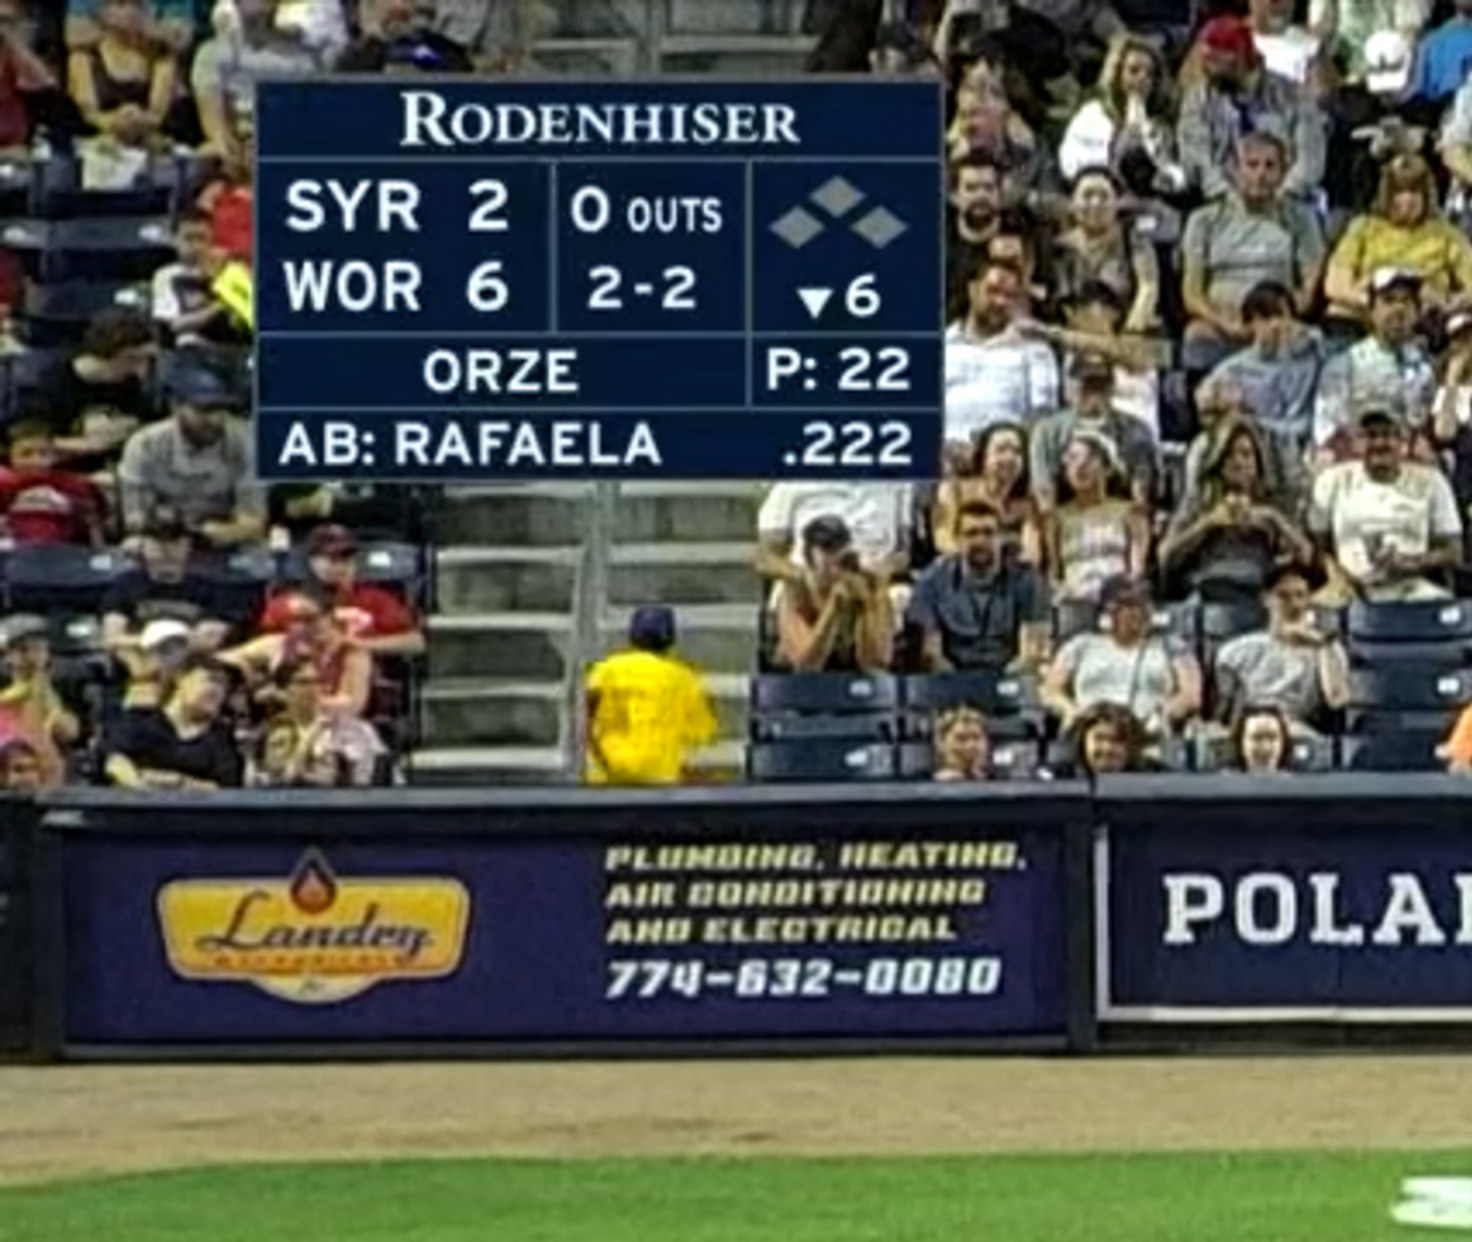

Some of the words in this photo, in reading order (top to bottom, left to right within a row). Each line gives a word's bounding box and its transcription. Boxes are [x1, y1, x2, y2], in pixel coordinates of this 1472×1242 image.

[605, 843, 824, 872] PLUMBING,
[840, 841, 1027, 870] HEATING,
[606, 881, 676, 908] AIR
[688, 878, 986, 907] CONDITIONING
[193, 893, 434, 962] Landry
[607, 917, 691, 944] AND
[702, 915, 956, 944] ELECTRICAL
[607, 957, 1002, 998] 774-632-0080
